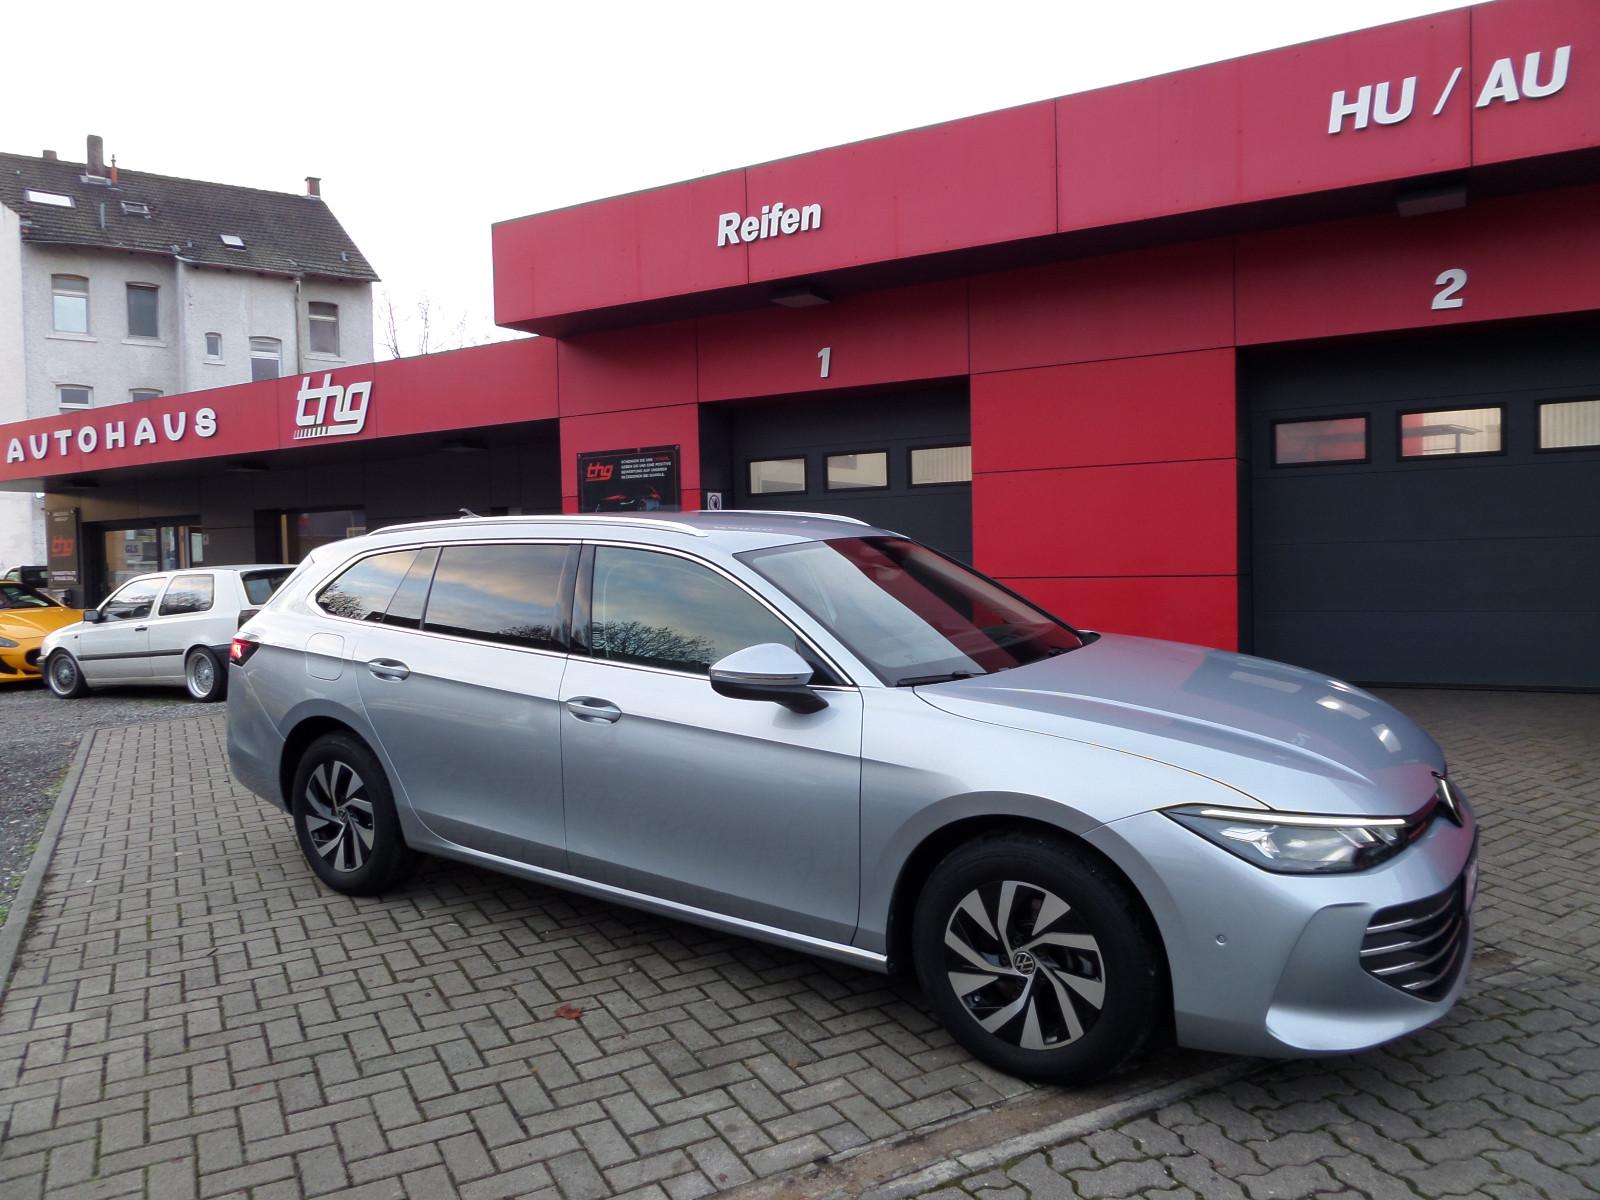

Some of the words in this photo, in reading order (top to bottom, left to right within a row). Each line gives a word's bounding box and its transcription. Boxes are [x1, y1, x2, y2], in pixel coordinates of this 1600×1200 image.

[1328, 76, 1416, 134] HU
[1433, 67, 1462, 115] /
[1475, 46, 1571, 107] AU
[718, 203, 821, 247] Reifen
[1431, 268, 1468, 310] 2
[817, 347, 831, 378] 1
[6, 407, 217, 464] AUTOHAUS
[293, 373, 373, 439] thg
[586, 462, 614, 481] thg
